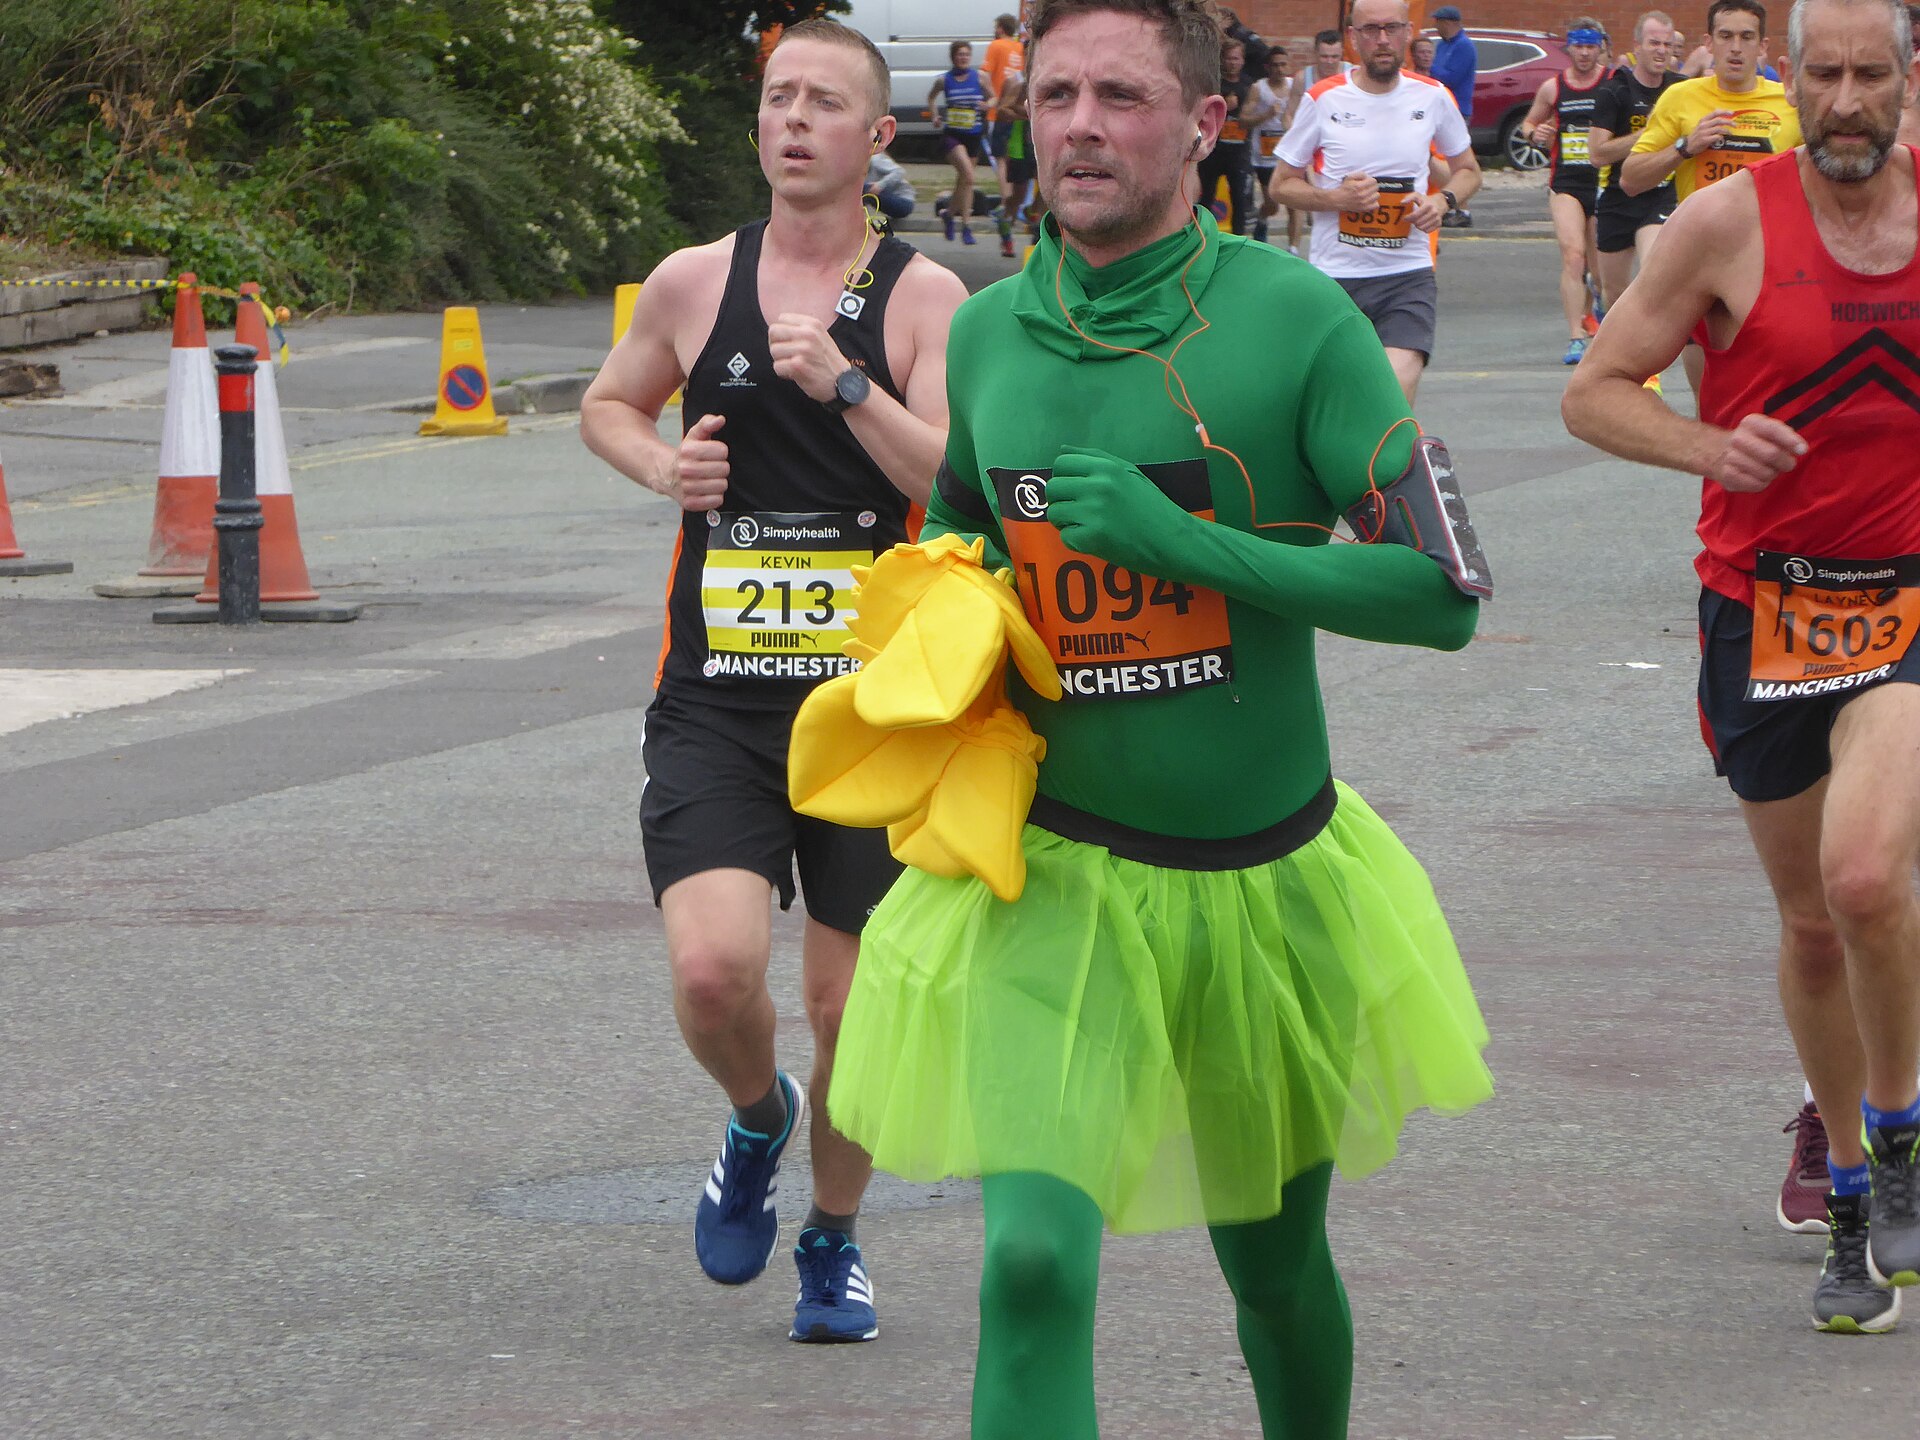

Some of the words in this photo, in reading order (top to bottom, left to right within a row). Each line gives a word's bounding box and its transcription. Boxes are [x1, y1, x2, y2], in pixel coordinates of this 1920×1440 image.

[1569, 140, 1586, 151] 27
[1703, 161, 1746, 181] 30
[1831, 301, 1920, 322] HORWICH
[762, 526, 840, 540] Simplyhealth
[761, 556, 812, 569] KEVIN
[1817, 568, 1896, 583] Simplyhealth
[736, 578, 836, 625] 213
[1024, 559, 1194, 624] 1094
[1814, 593, 1868, 607] LAYNE
[751, 632, 803, 648] PUMA
[1058, 632, 1125, 656] PUMA
[1779, 610, 1903, 658] 1603
[714, 653, 863, 677] MANCHESTER
[1058, 655, 1224, 695] NCHESTER
[1752, 663, 1892, 699] MANCHESTER
